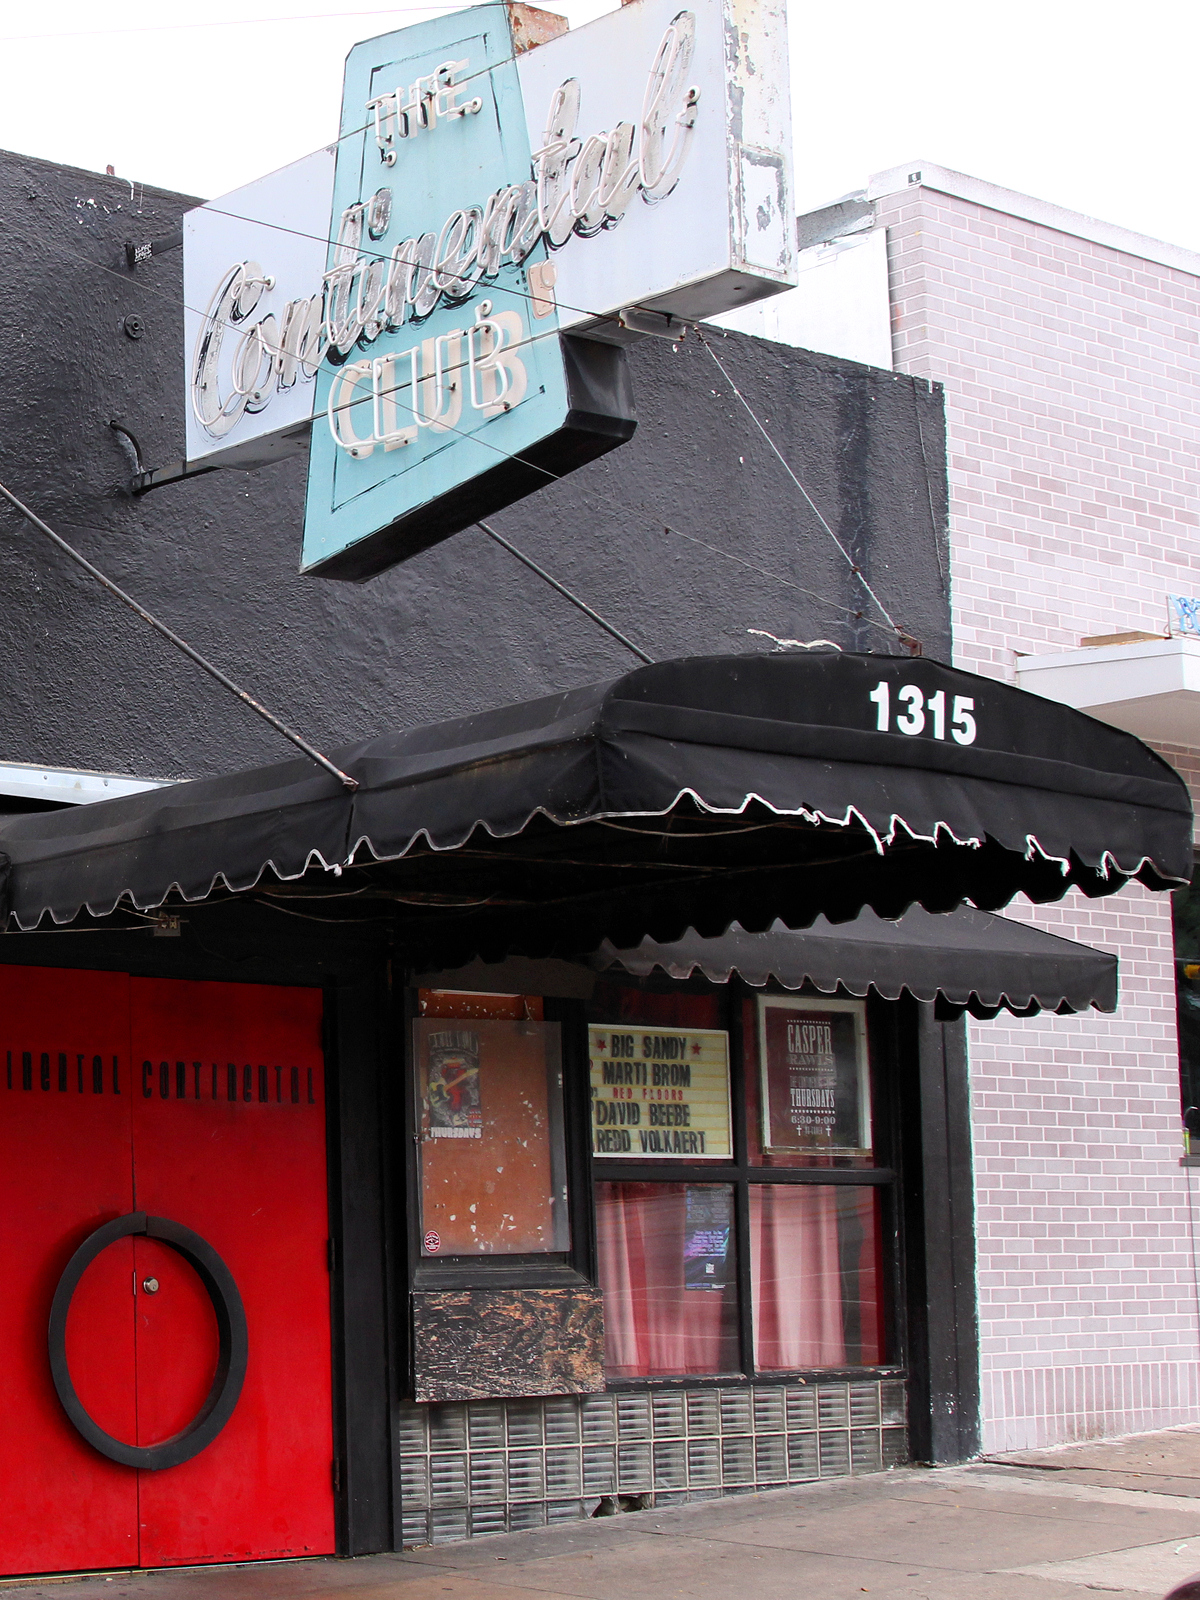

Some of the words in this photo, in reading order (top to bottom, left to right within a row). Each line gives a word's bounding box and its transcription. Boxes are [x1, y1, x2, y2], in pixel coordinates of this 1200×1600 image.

[365, 57, 483, 152] THE
[191, 10, 701, 437] Continental
[328, 302, 528, 459] CLUB
[869, 681, 977, 746] 1315
[611, 1034, 634, 1058] BIG
[643, 1036, 687, 1060] SANDY
[787, 1024, 833, 1055] CASPER
[788, 1054, 834, 1066] RAWLS
[602, 1061, 648, 1086] MARTI
[652, 1063, 691, 1088] BROM
[613, 1087, 633, 1099] RED
[790, 1088, 835, 1108] THURSDAYS
[596, 1100, 641, 1126] DAVID
[649, 1103, 691, 1127] BEEBE
[791, 1115, 836, 1125] 6:30-9:00
[430, 1126, 482, 1139] THURSDAYS
[596, 1129, 631, 1153] REDD
[638, 1130, 706, 1154] VOLKAERT
